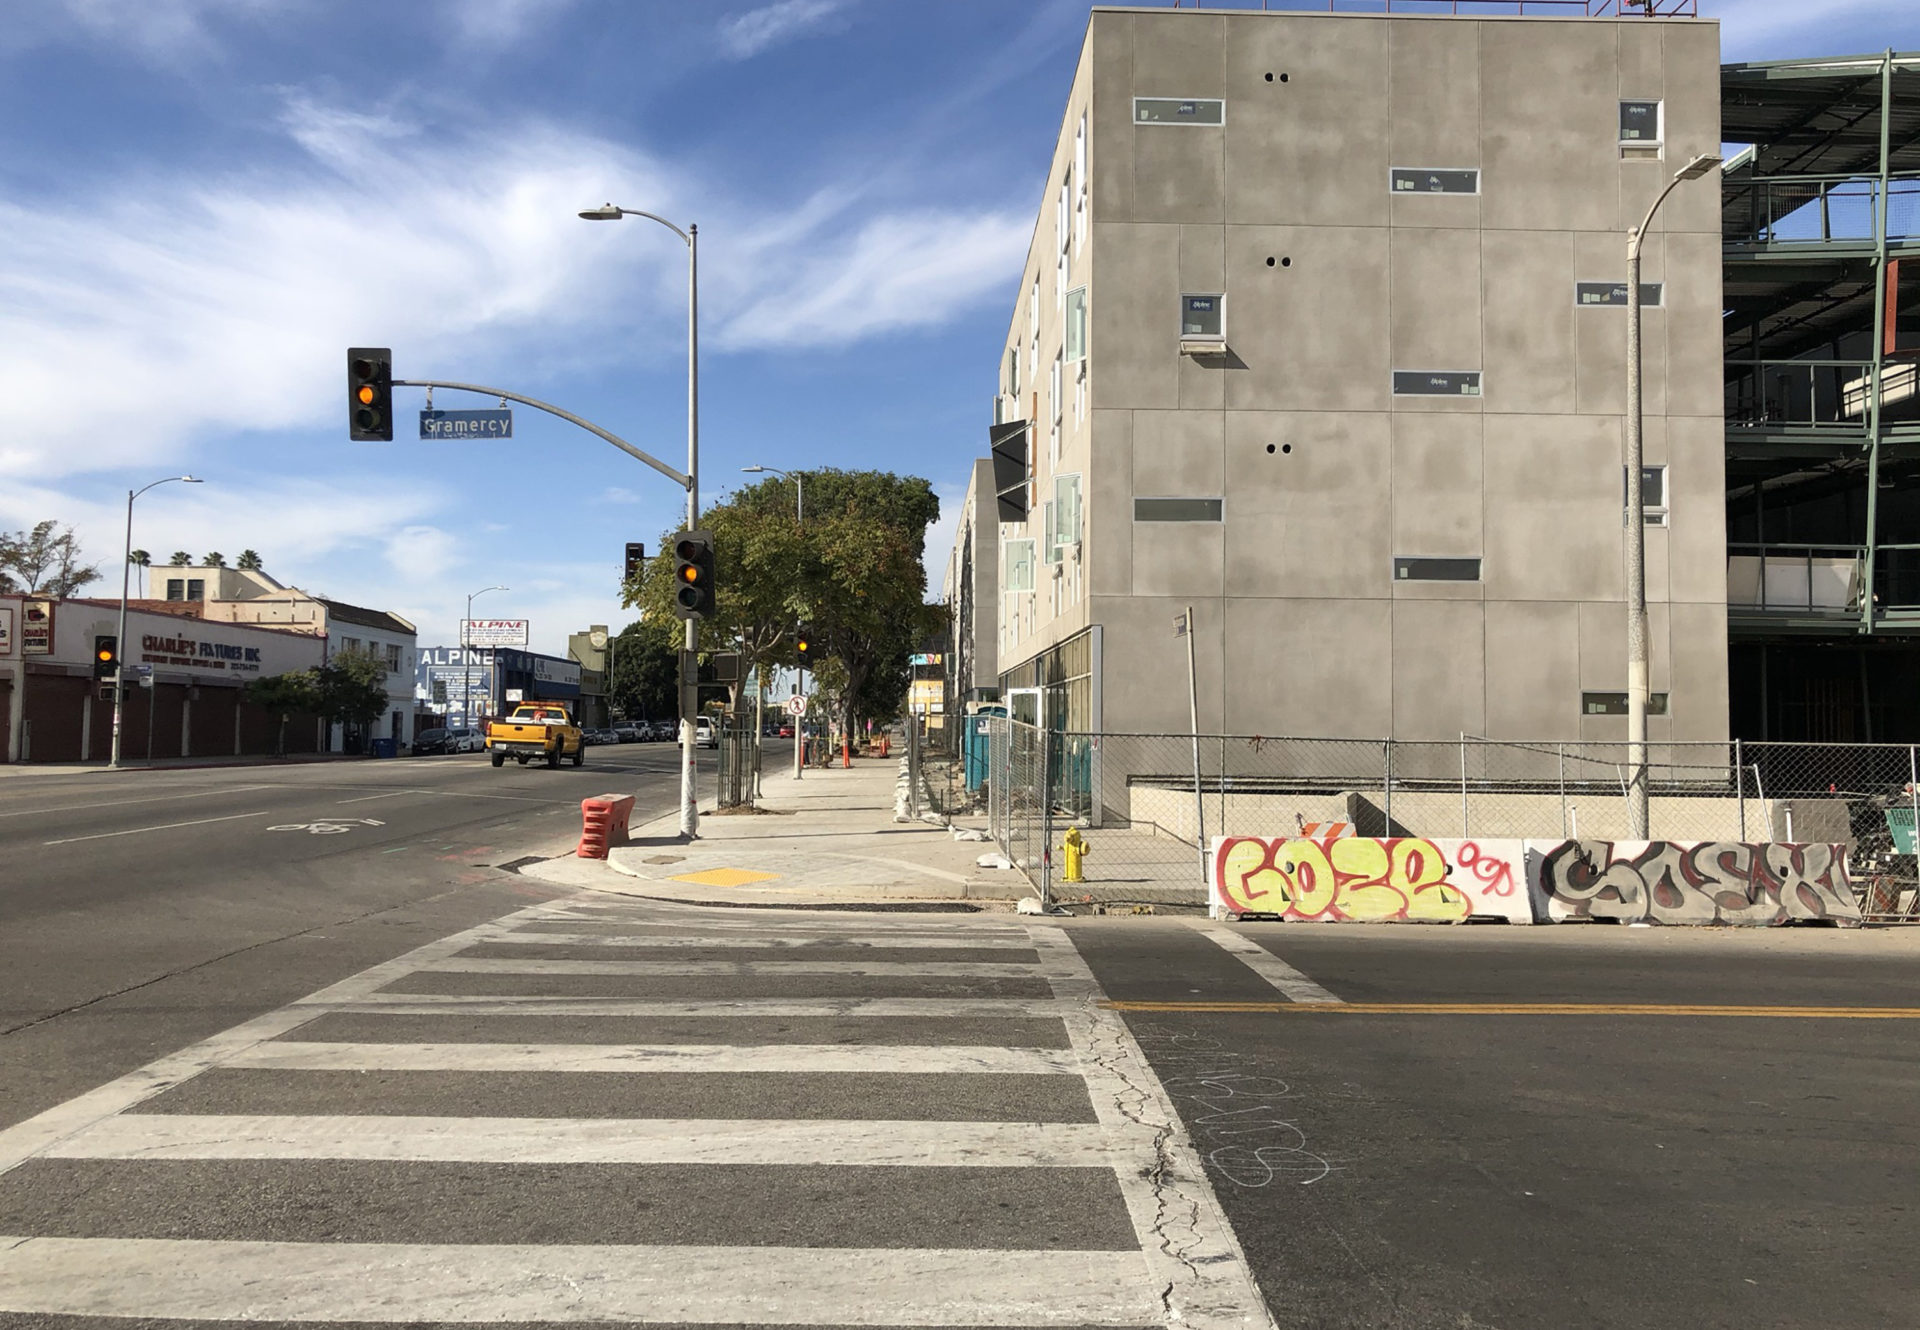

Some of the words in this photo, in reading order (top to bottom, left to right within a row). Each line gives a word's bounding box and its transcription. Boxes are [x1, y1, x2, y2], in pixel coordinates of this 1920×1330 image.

[425, 418, 509, 434] Gramercy
[142, 633, 196, 656] CHARLIE'S
[421, 650, 494, 664] ALPINE
